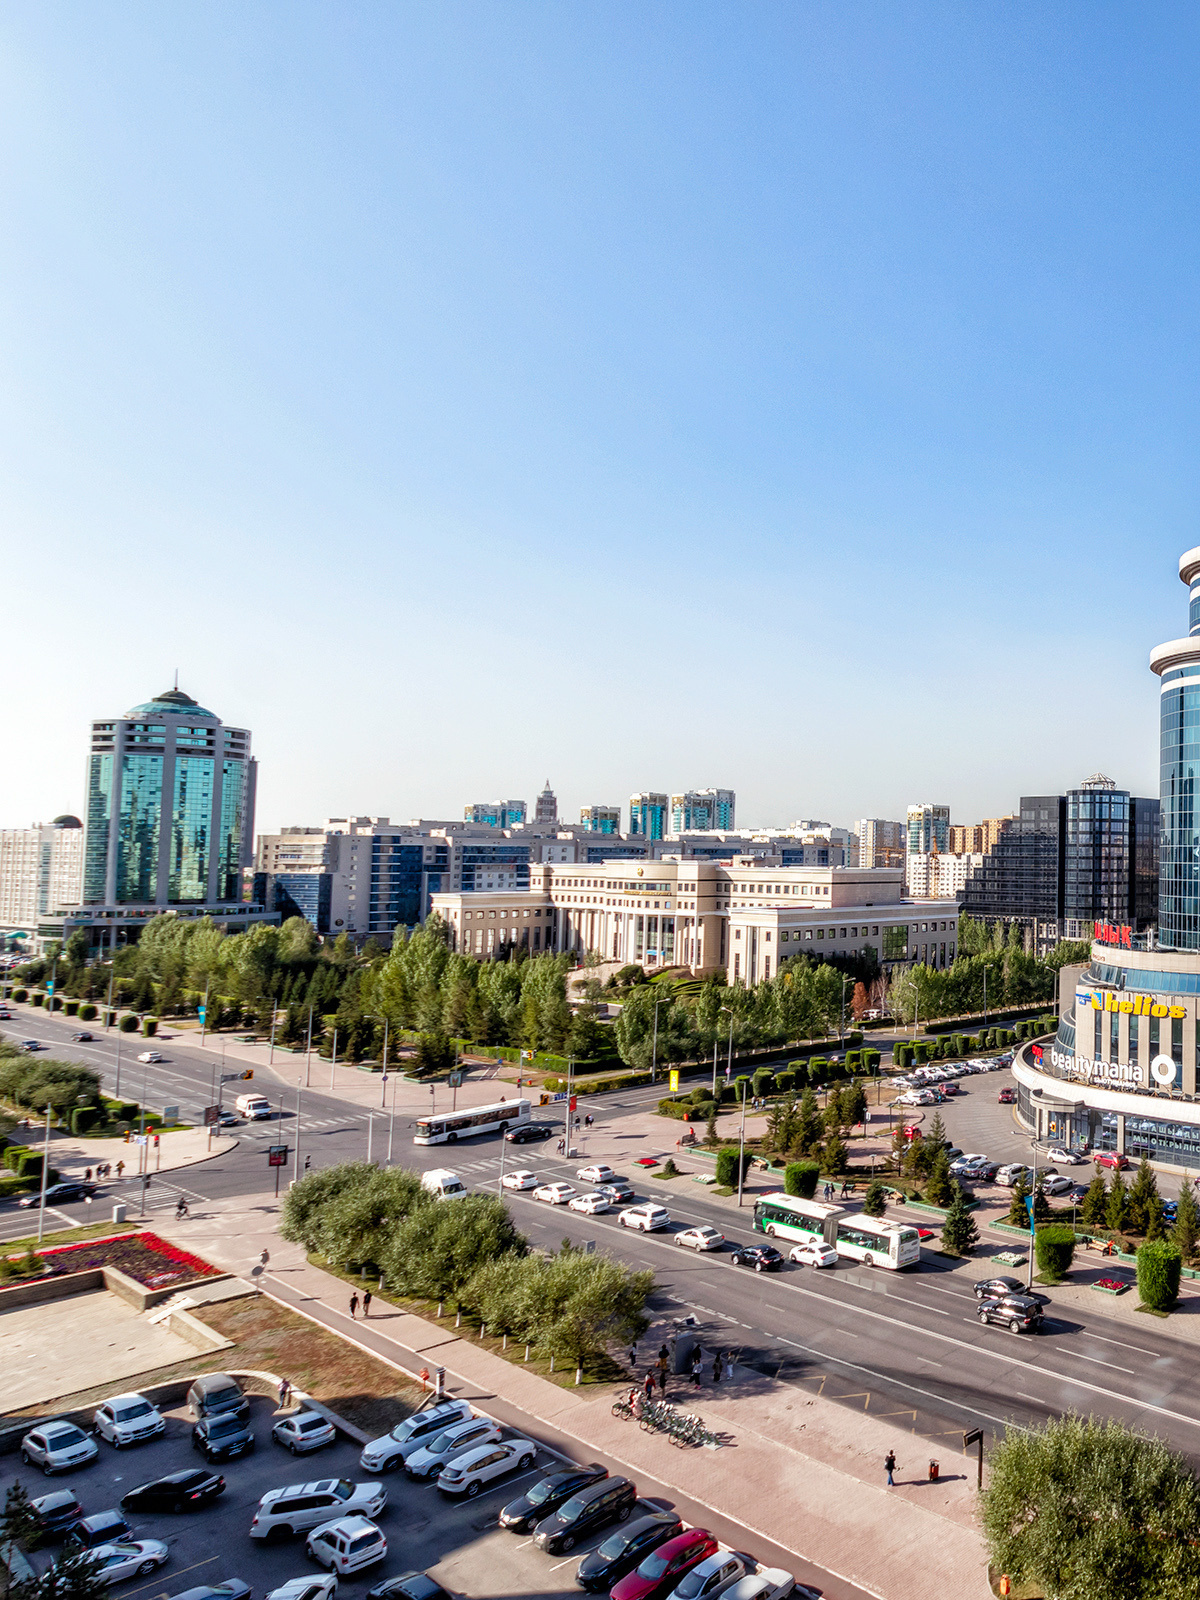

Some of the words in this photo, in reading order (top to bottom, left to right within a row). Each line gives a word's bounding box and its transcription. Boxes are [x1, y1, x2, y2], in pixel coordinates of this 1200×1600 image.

[1105, 992, 1186, 1019] helios
[1050, 1046, 1144, 1082] beautymania
[1133, 1135, 1148, 1143] МЫ
